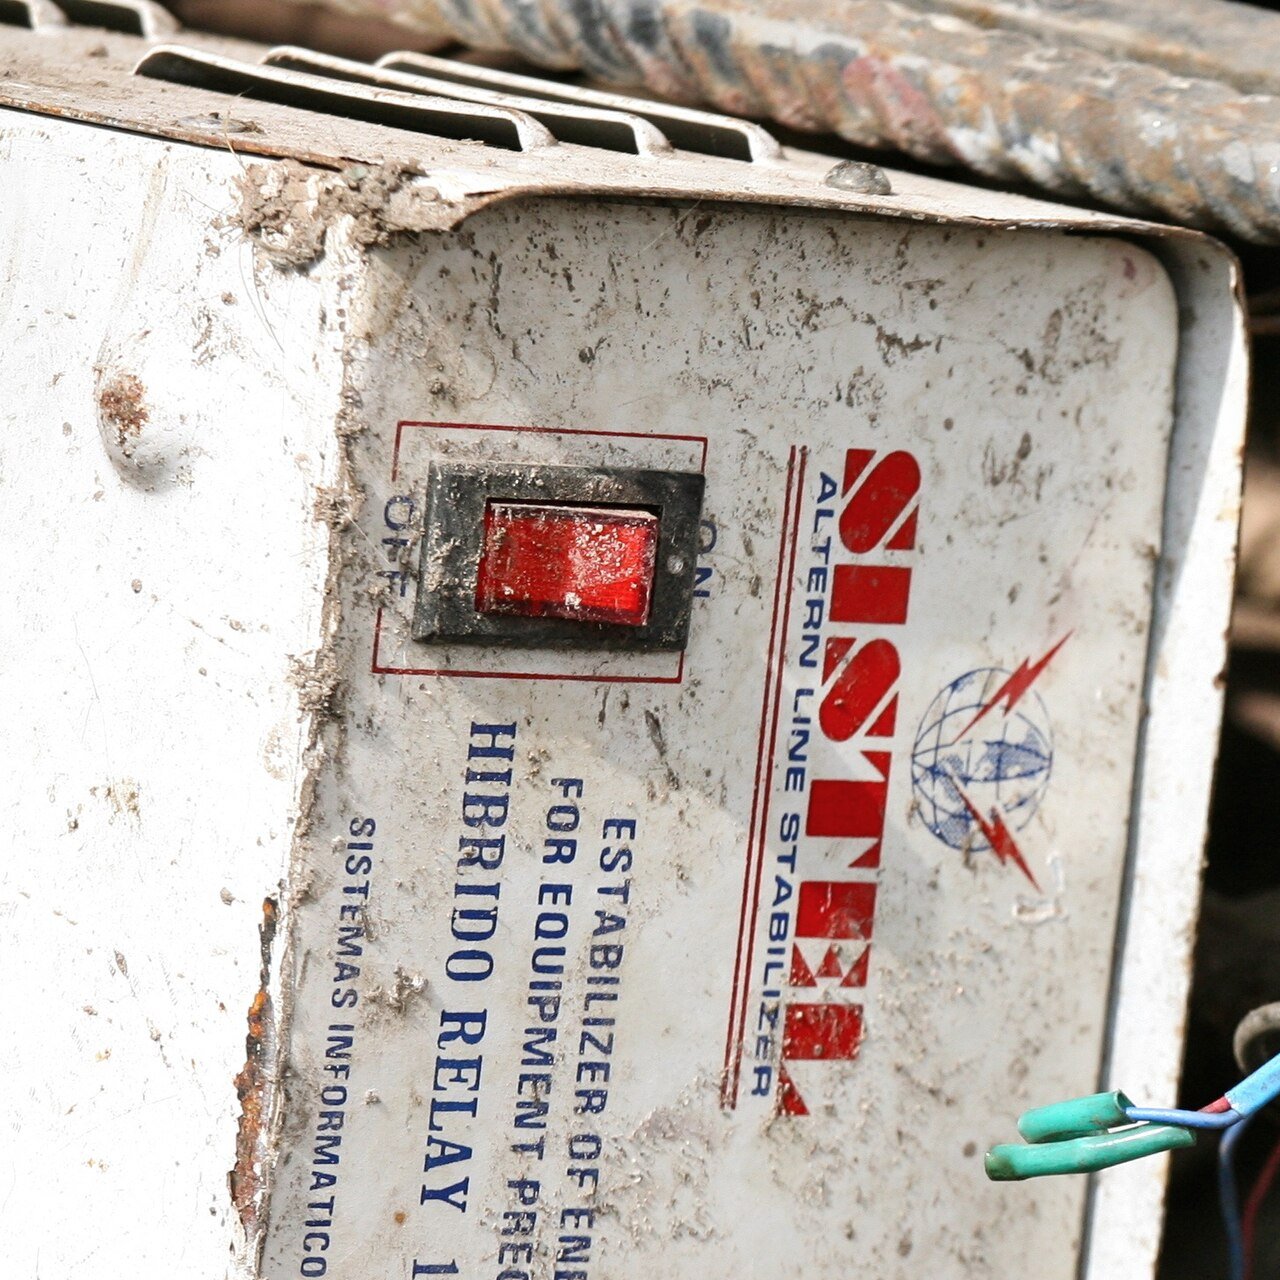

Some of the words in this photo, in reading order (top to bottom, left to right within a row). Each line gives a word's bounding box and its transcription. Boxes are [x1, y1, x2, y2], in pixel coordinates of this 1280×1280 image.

[801, 474, 837, 668] ALTERN
[544, 779, 582, 864] FOR
[780, 447, 921, 1116] SISTEL
[787, 688, 813, 789] LINE
[335, 820, 375, 1007] SISTEMAS
[448, 721, 517, 983] HIBRIDO
[513, 883, 573, 1161] EQUIPMENT
[577, 819, 637, 1112] ESTABILIZER
[753, 814, 801, 1096] STABILIZER
[420, 1010, 489, 1215] RELAY
[567, 1135, 601, 1188] OF
